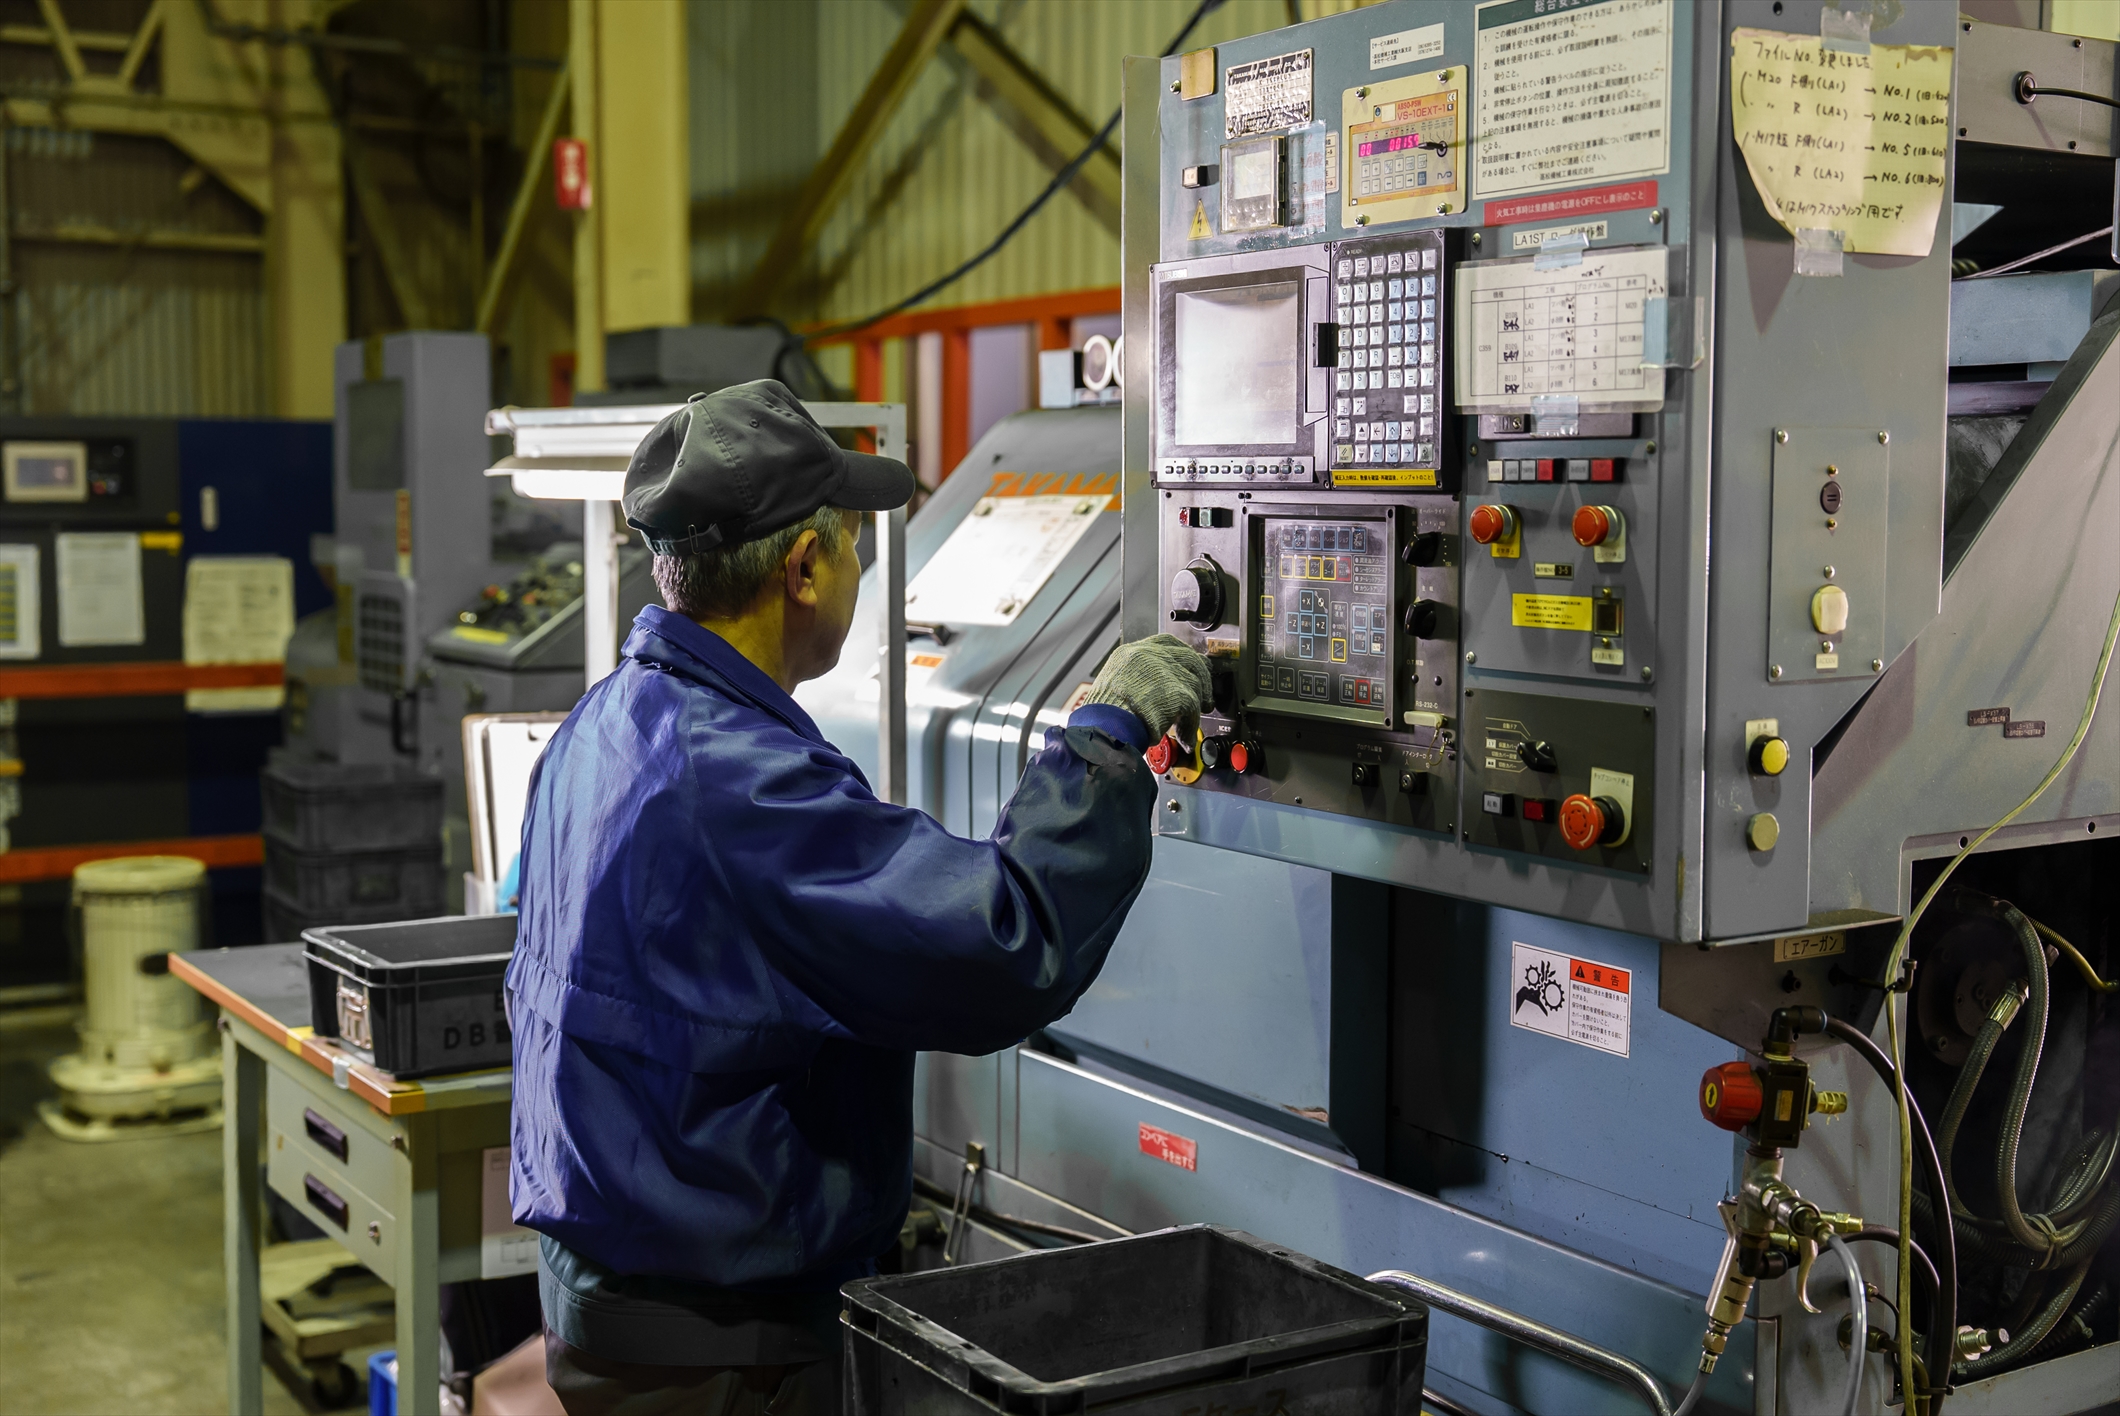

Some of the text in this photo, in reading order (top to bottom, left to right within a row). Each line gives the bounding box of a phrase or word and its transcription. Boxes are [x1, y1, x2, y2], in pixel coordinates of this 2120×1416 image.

[1534, 0, 1596, 13] 総合安全
[1397, 104, 1446, 120] VS-10EXT-1
[1360, 142, 1372, 157] 00
[1416, 700, 1438, 709] RS-232-C
[1791, 935, 1838, 956] エアーガン
[1593, 969, 1620, 987] 警告
